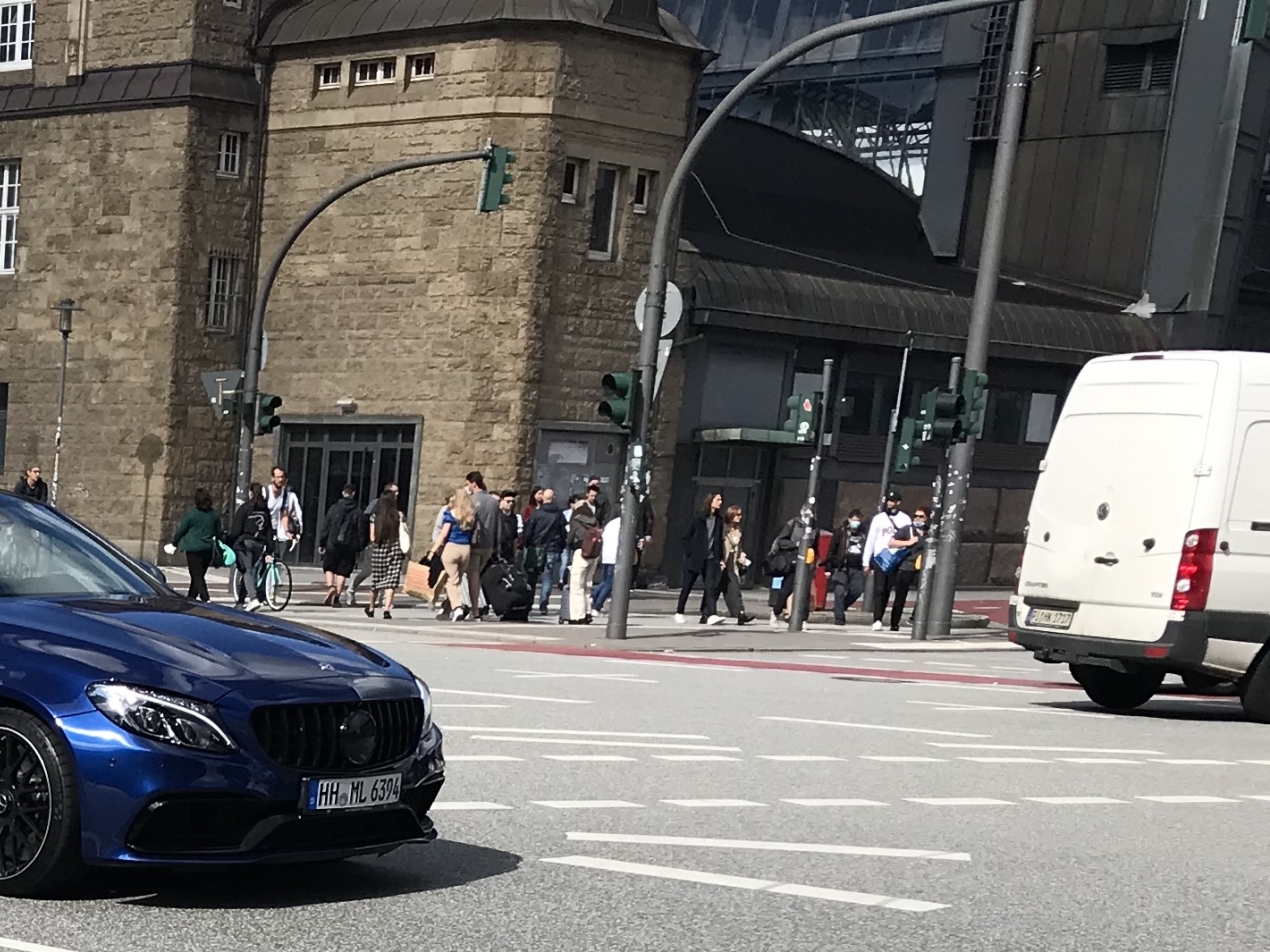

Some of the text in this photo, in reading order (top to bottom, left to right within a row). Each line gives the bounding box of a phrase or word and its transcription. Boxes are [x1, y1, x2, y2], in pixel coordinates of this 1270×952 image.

[318, 781, 339, 806] HH
[350, 780, 367, 804] ML
[371, 776, 399, 802] 6394
